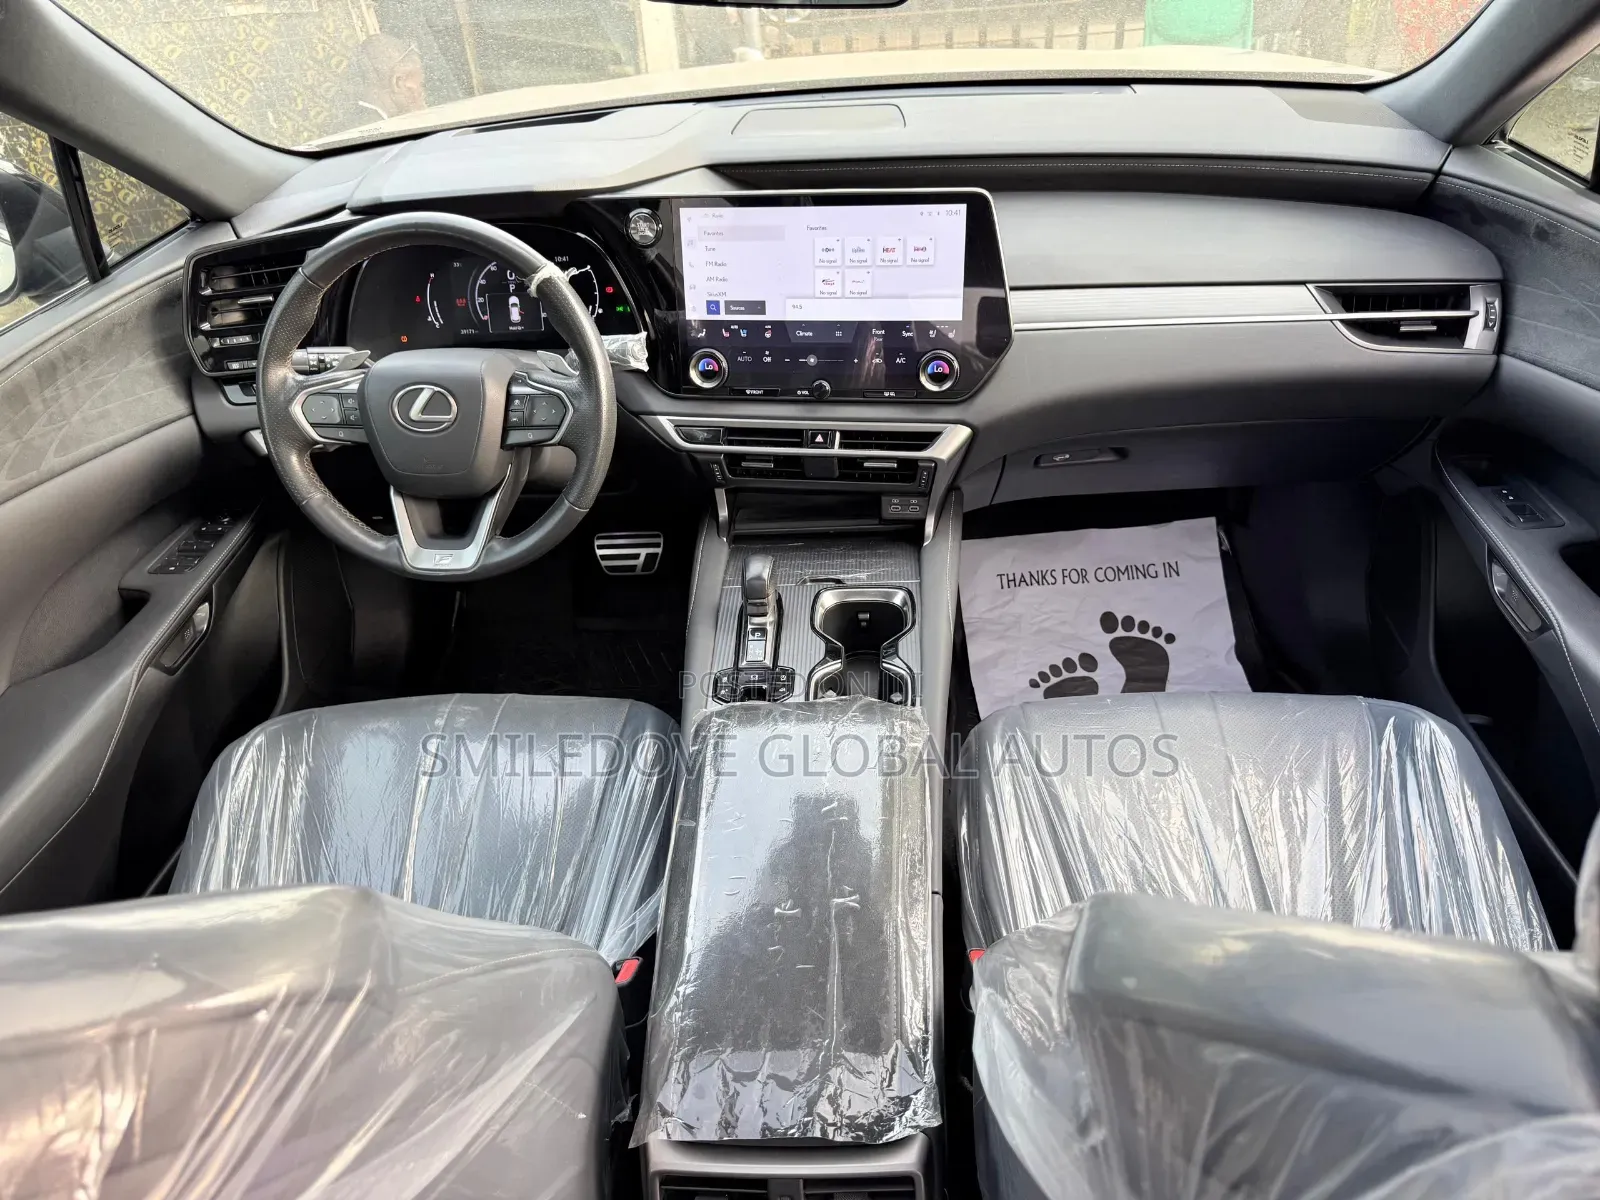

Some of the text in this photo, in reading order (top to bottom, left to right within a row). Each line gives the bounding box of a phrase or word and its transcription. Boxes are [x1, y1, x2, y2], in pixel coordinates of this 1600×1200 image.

[510, 284, 516, 292] P
[996, 560, 1181, 590] THANKS FOR COMING IN
